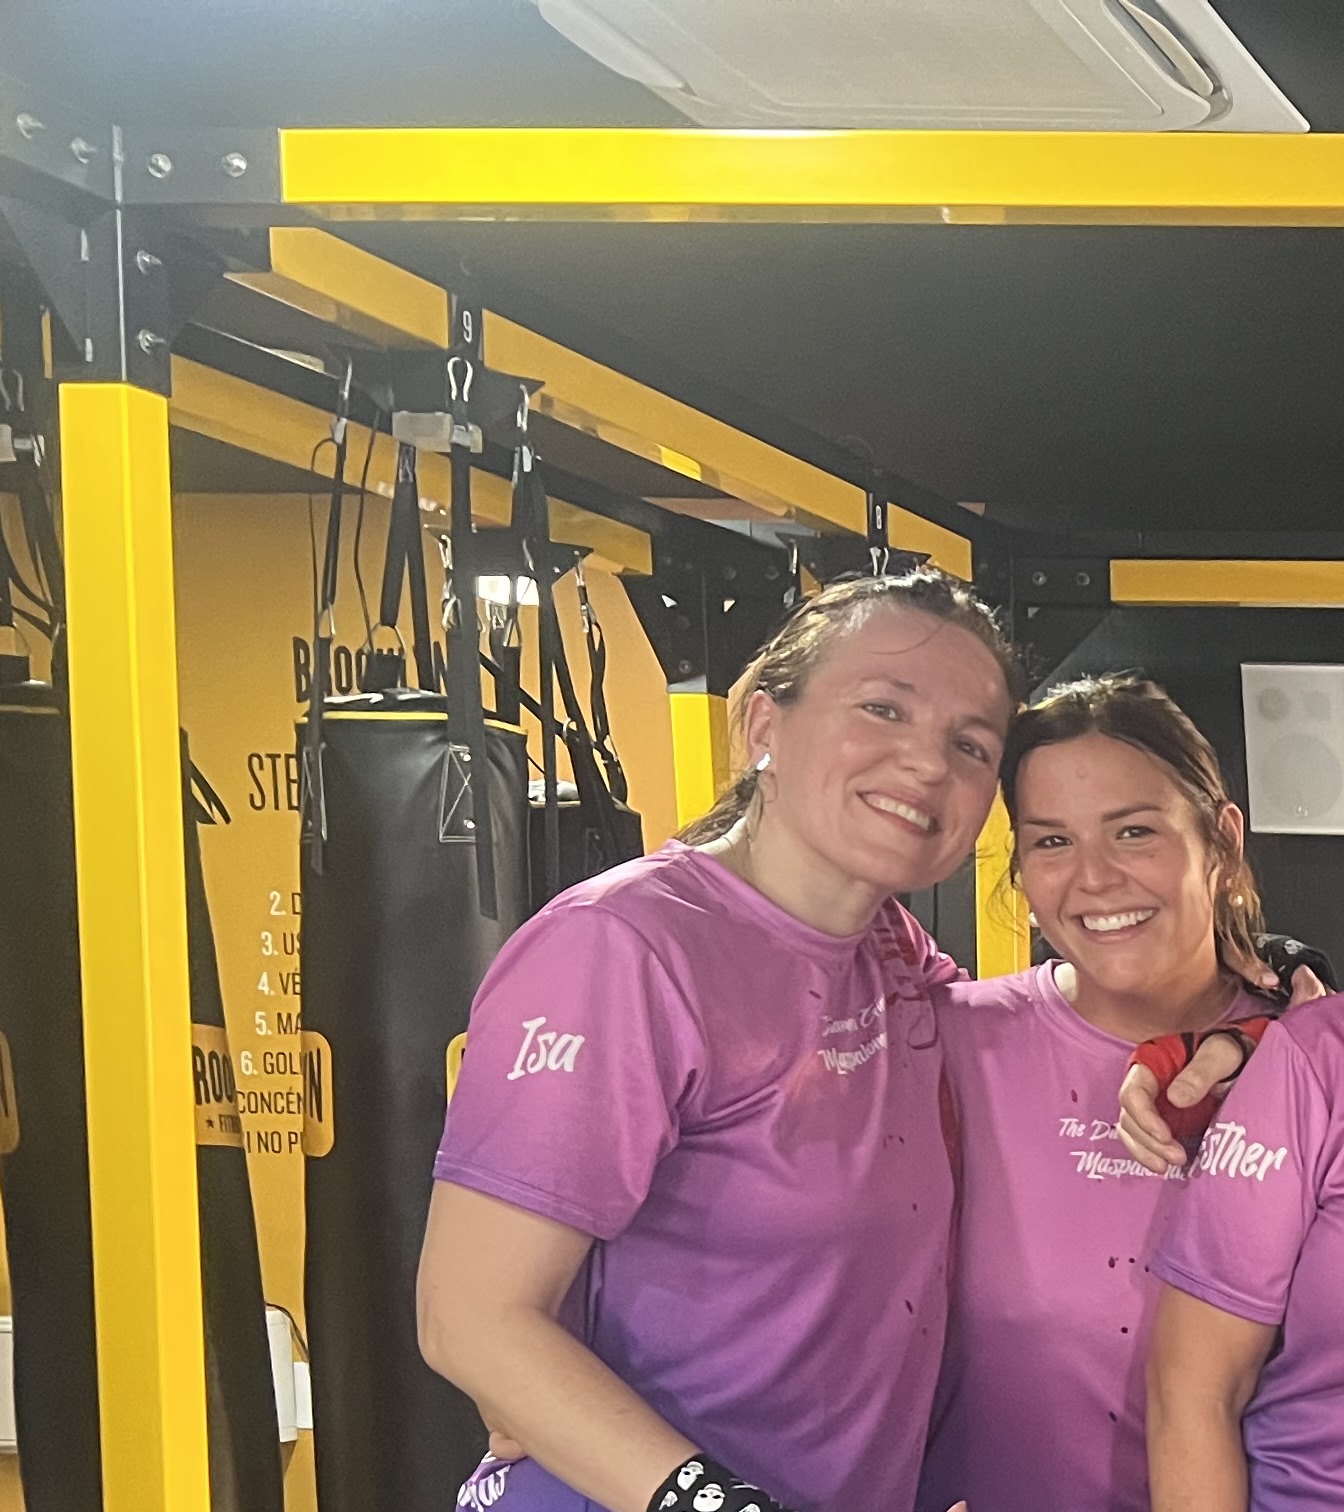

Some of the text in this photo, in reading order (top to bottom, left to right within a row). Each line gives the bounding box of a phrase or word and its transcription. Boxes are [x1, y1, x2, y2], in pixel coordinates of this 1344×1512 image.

[462, 310, 473, 343] 9
[269, 890, 287, 916] 2.
[260, 931, 279, 956] 3.
[257, 971, 275, 996] 4.
[255, 1011, 273, 1036] 5.
[506, 1016, 586, 1080] Isa
[240, 1050, 302, 1076] 6. GOL
[1059, 1117, 1086, 1138] The
[256, 1130, 283, 1154] NO
